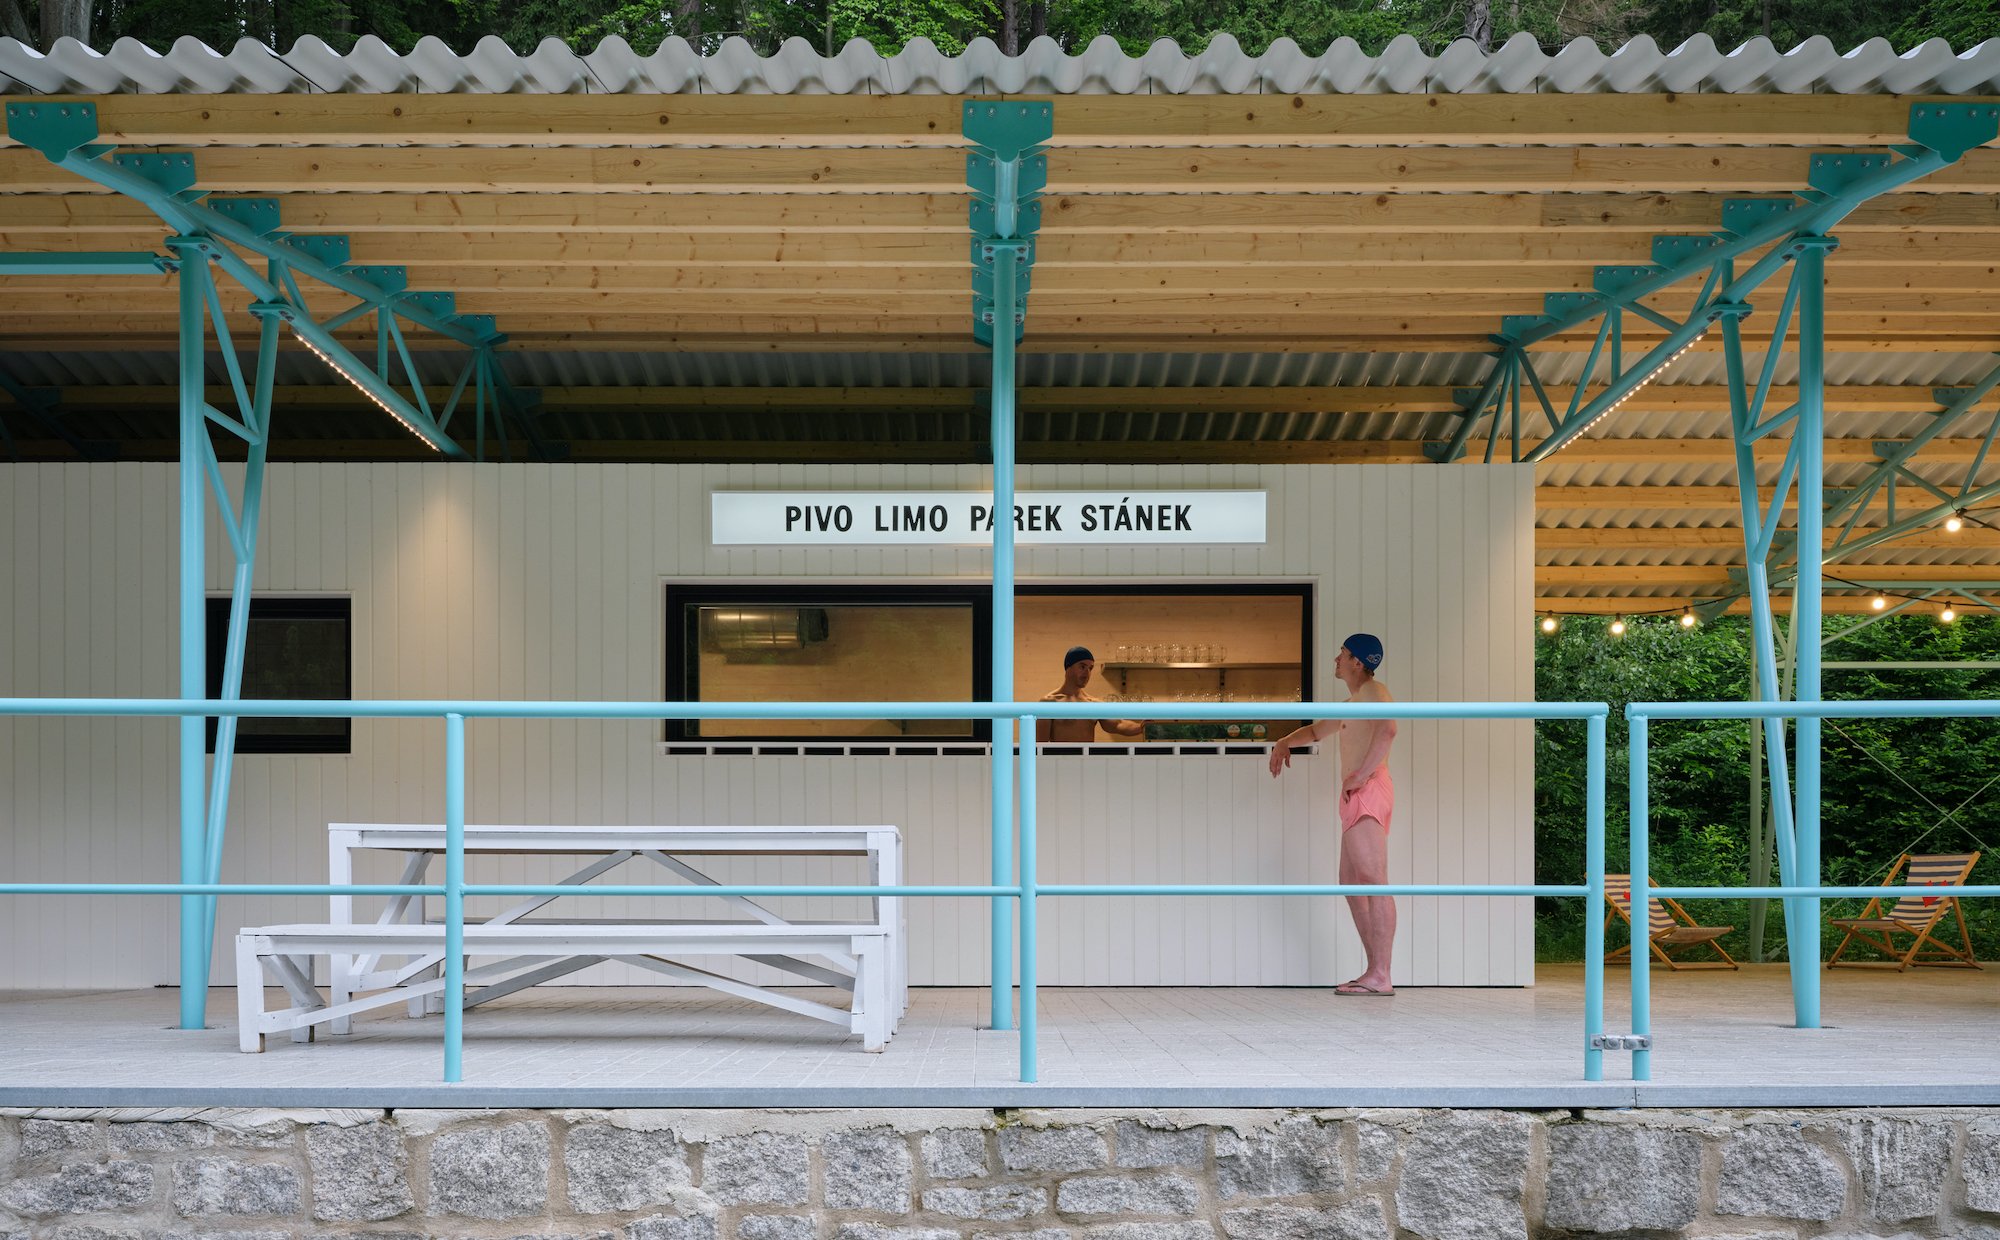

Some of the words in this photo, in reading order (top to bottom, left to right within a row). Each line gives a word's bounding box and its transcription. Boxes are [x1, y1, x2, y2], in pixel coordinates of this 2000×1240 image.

[785, 504, 853, 533] PIVO
[875, 504, 948, 533] LIMO
[1080, 496, 1192, 532] STÁNEK
